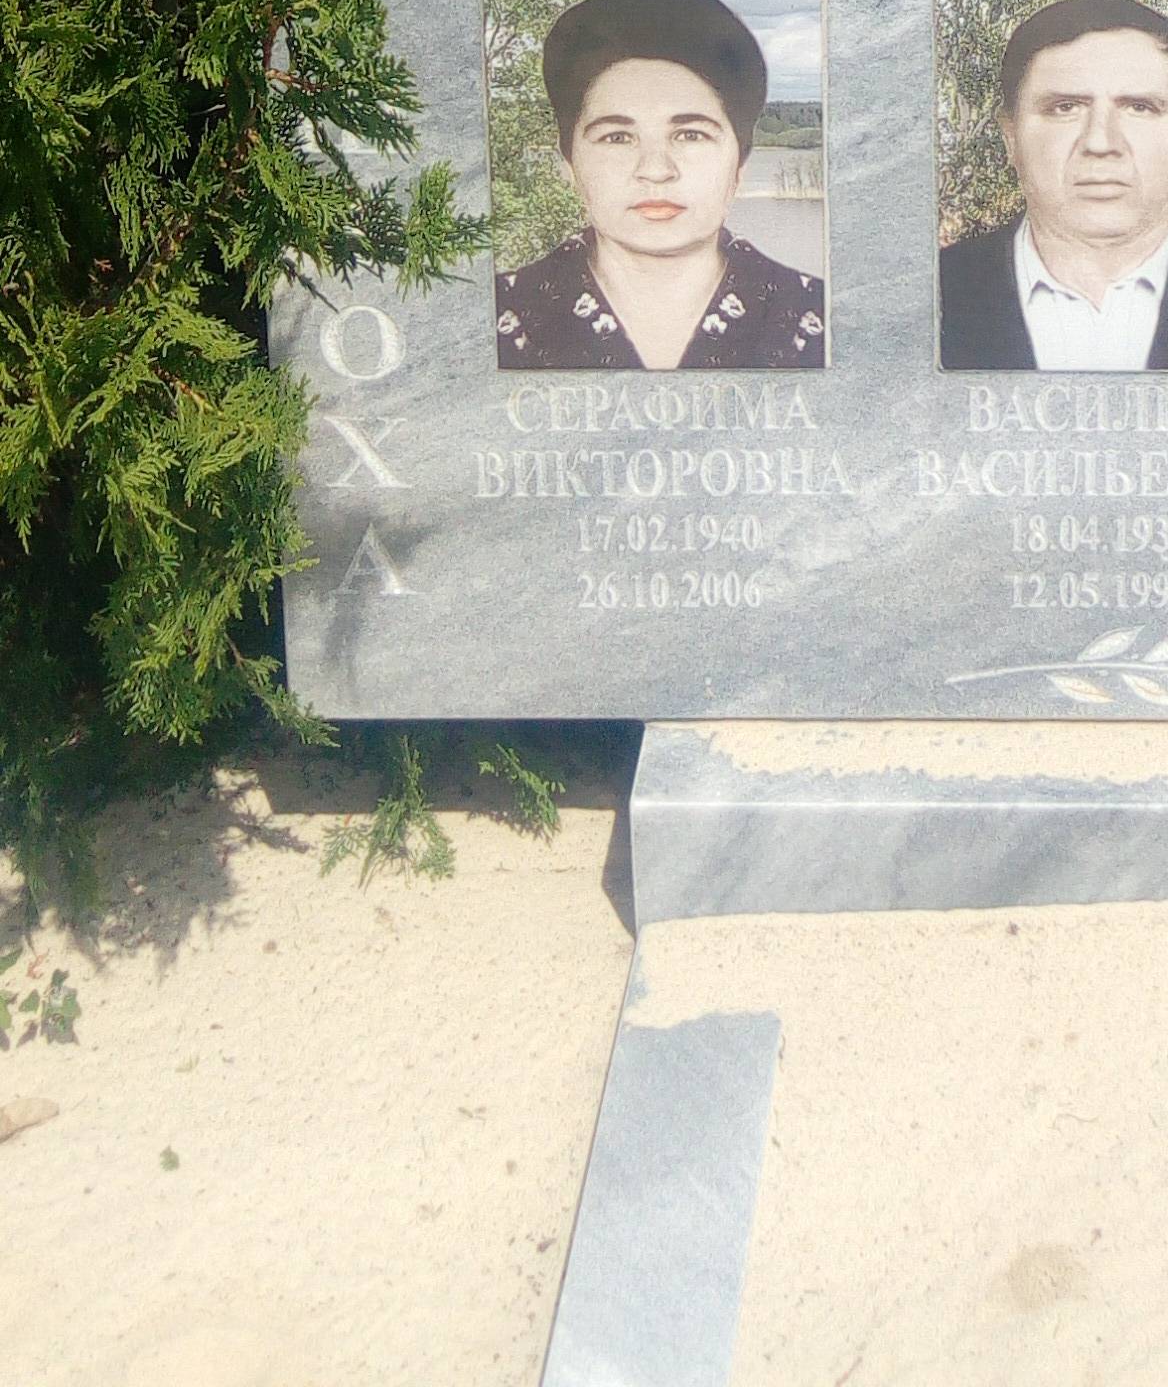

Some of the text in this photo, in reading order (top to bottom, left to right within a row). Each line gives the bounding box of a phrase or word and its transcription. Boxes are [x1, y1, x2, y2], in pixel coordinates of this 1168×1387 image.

[506, 383, 817, 432] СЕРАФИМА
[472, 448, 857, 499] ВИКТОРОВНА
[577, 514, 763, 555] 17.02.1940
[577, 570, 762, 611] 26.10.2006
